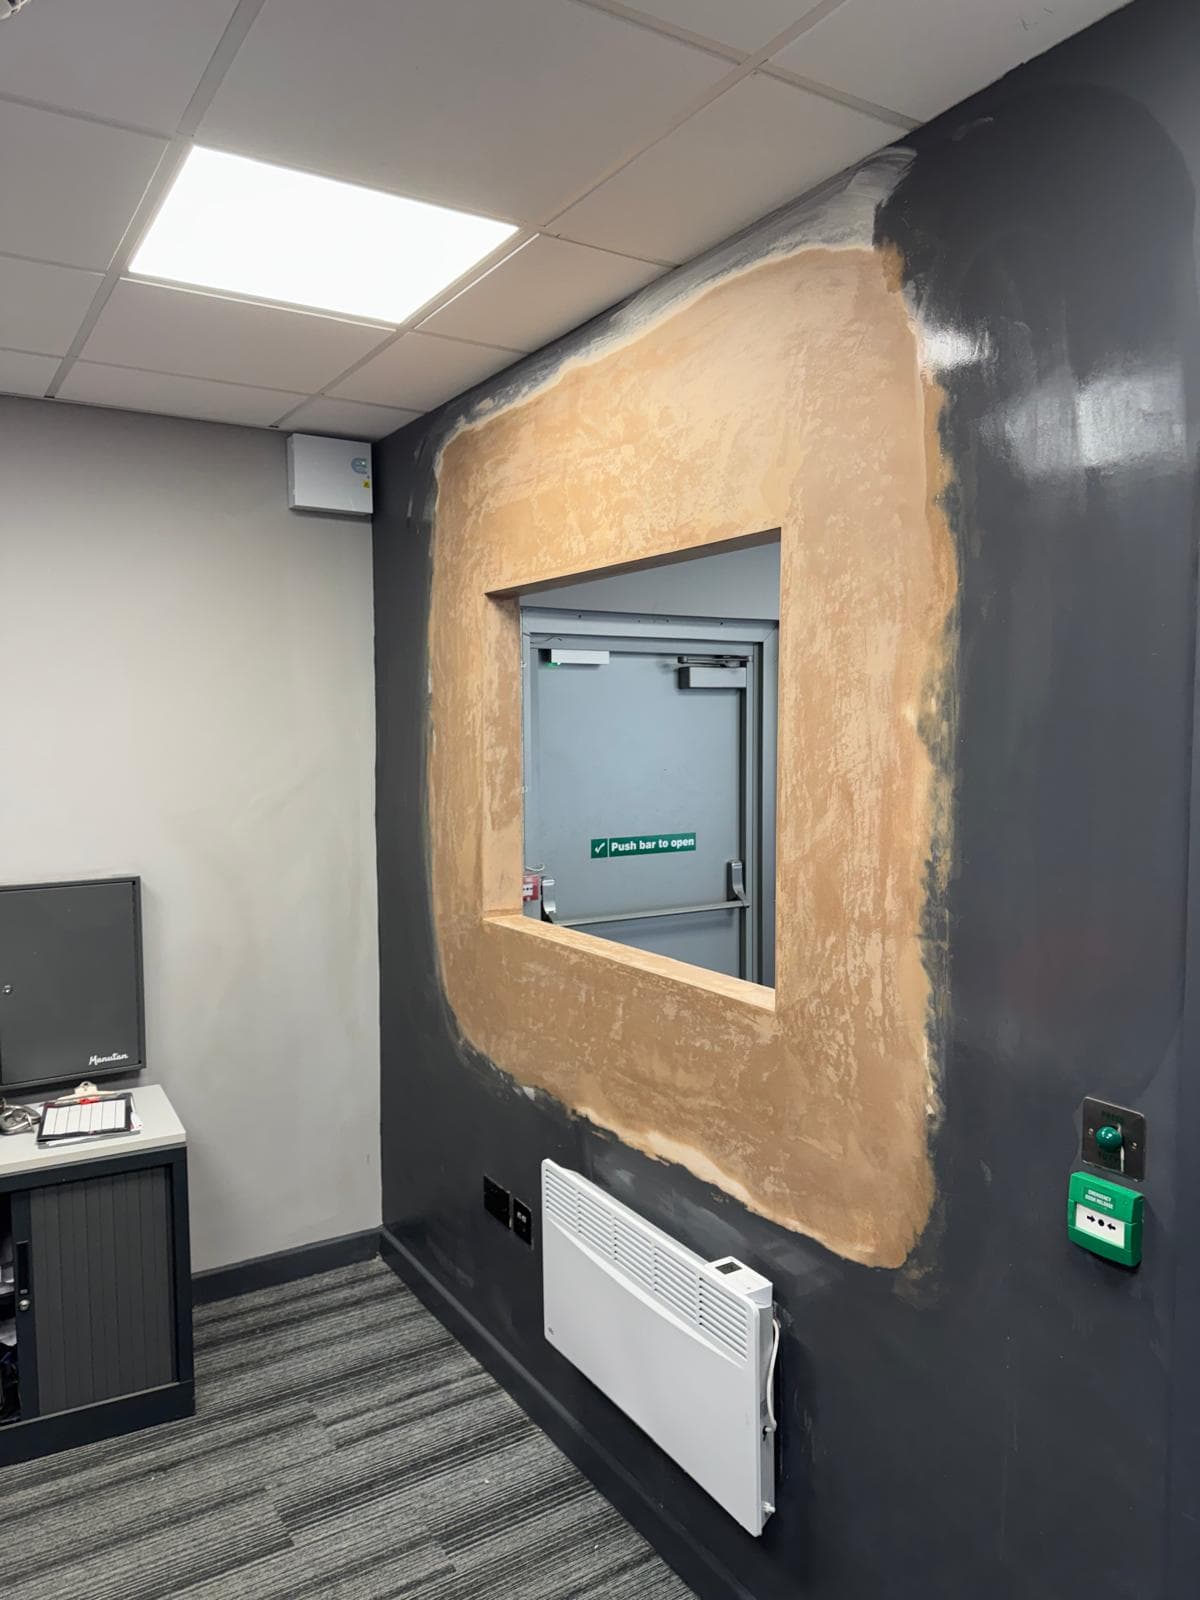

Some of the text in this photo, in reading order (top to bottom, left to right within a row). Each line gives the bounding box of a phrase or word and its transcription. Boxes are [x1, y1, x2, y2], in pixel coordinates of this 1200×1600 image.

[611, 838, 694, 852] Push bar to open
[88, 1052, 129, 1066] Manutan
